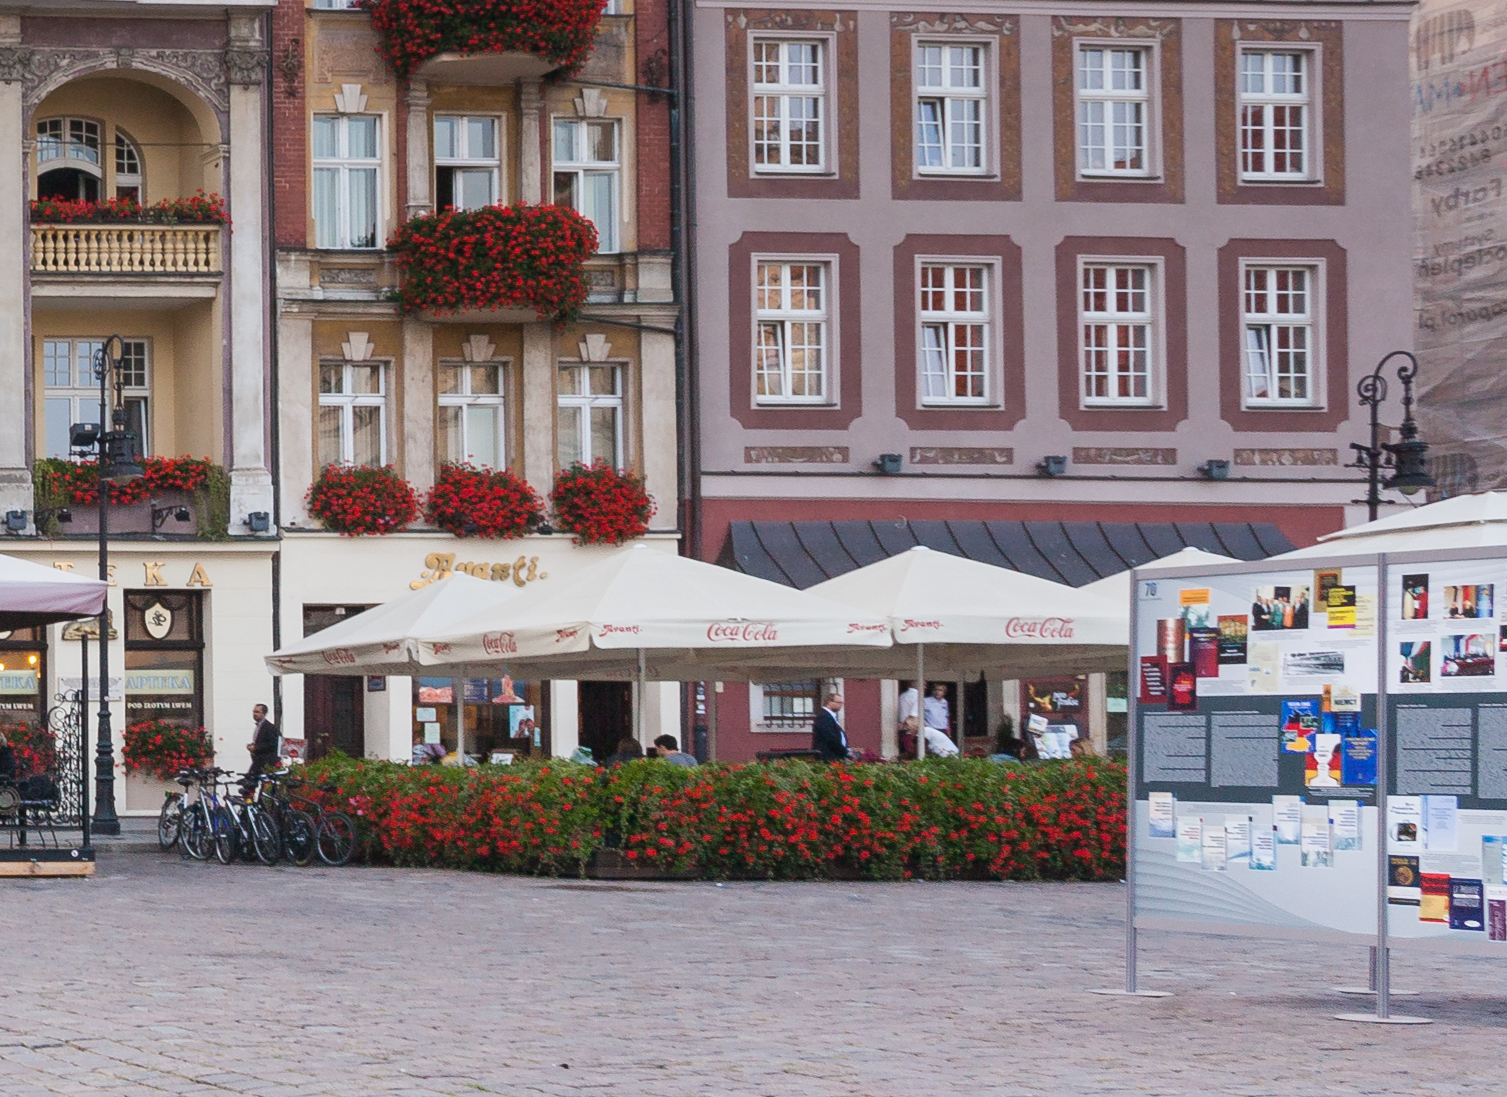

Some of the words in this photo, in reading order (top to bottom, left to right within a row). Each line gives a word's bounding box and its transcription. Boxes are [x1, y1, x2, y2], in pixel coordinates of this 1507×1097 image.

[52, 561, 213, 587] TEKA
[125, 675, 192, 690] APTEKA
[127, 701, 143, 709] POD
